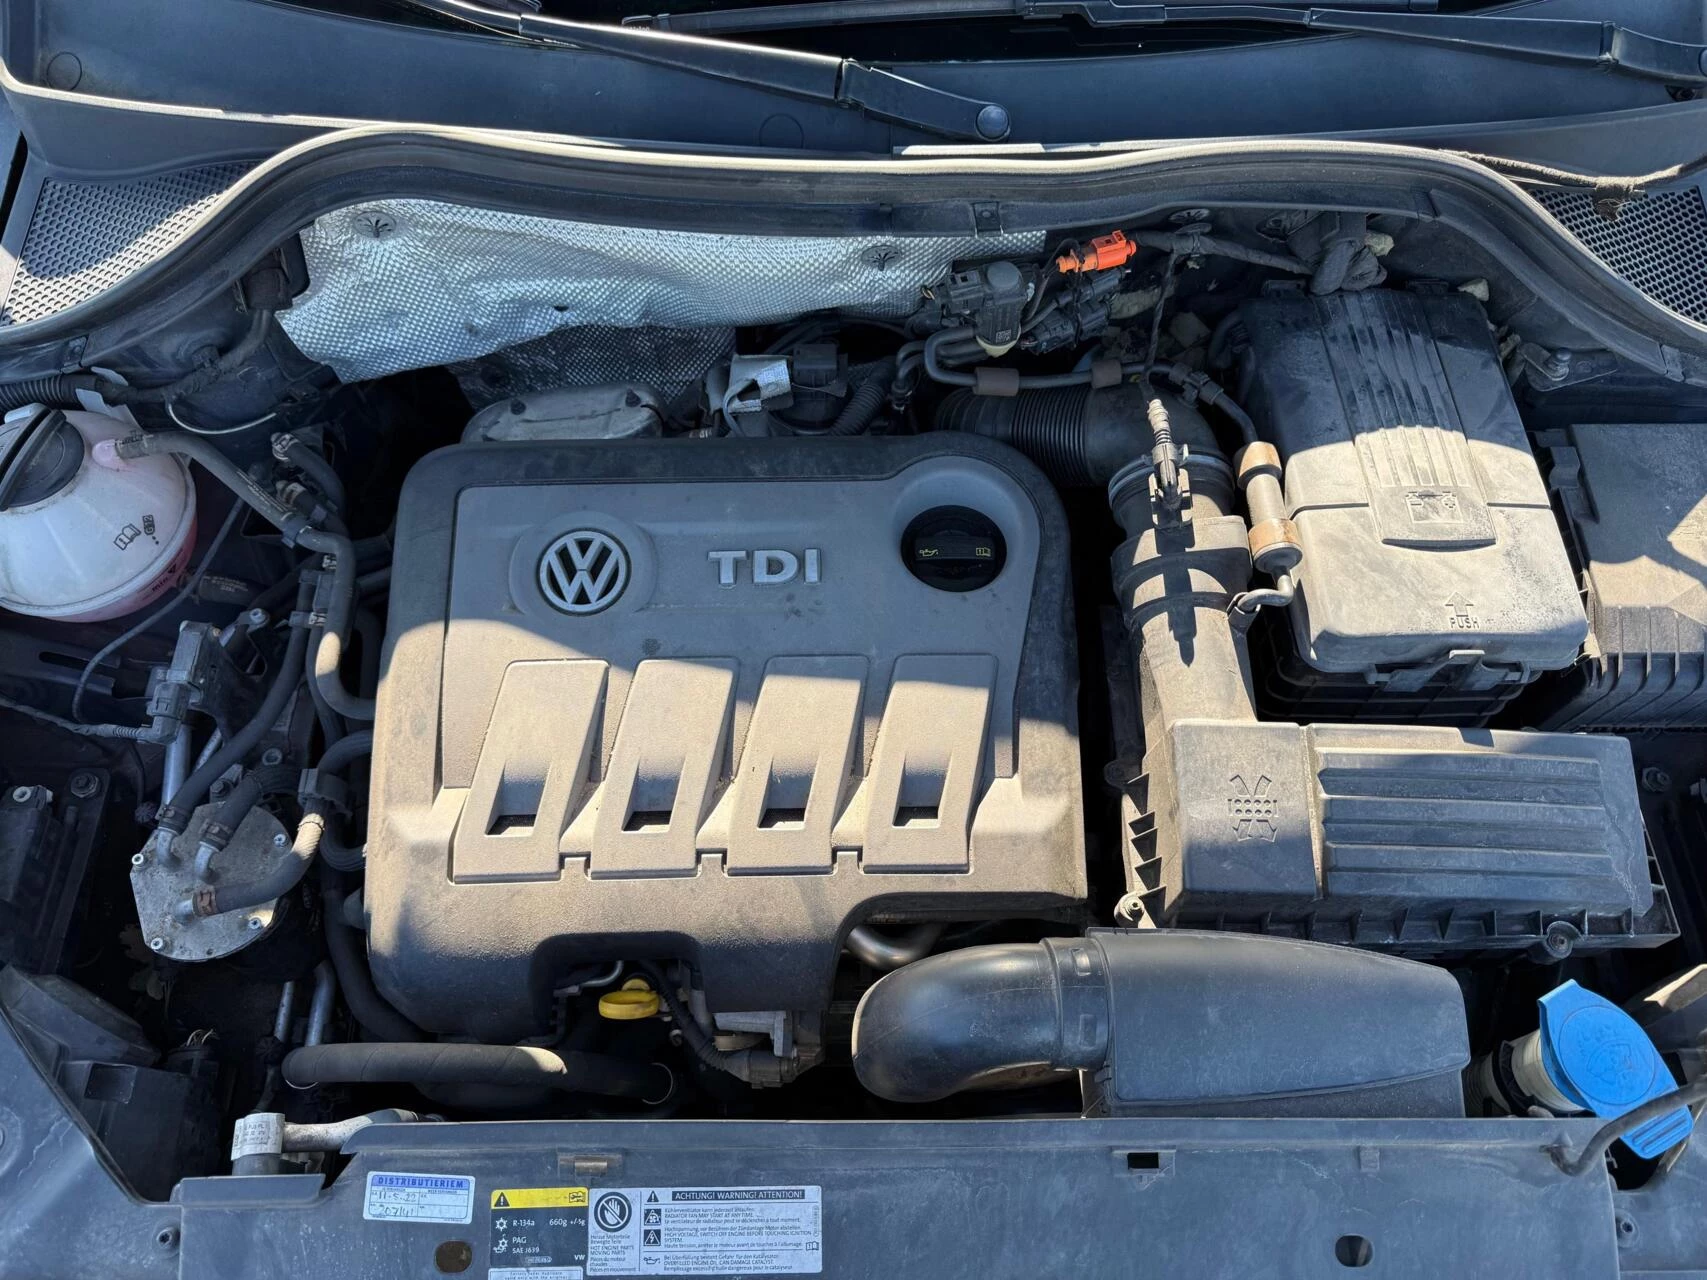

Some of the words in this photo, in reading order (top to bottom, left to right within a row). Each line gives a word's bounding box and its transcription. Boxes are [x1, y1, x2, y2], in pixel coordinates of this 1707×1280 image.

[707, 548, 821, 585] TDI
[1449, 617, 1480, 629] PUSH
[378, 1176, 464, 1188] DISTRIBUTIERIEM
[675, 1192, 716, 1200] ACHTUNG!
[717, 1191, 757, 1200] WARNING!
[758, 1191, 803, 1199] ATTENTION!
[549, 1218, 568, 1227] 660g
